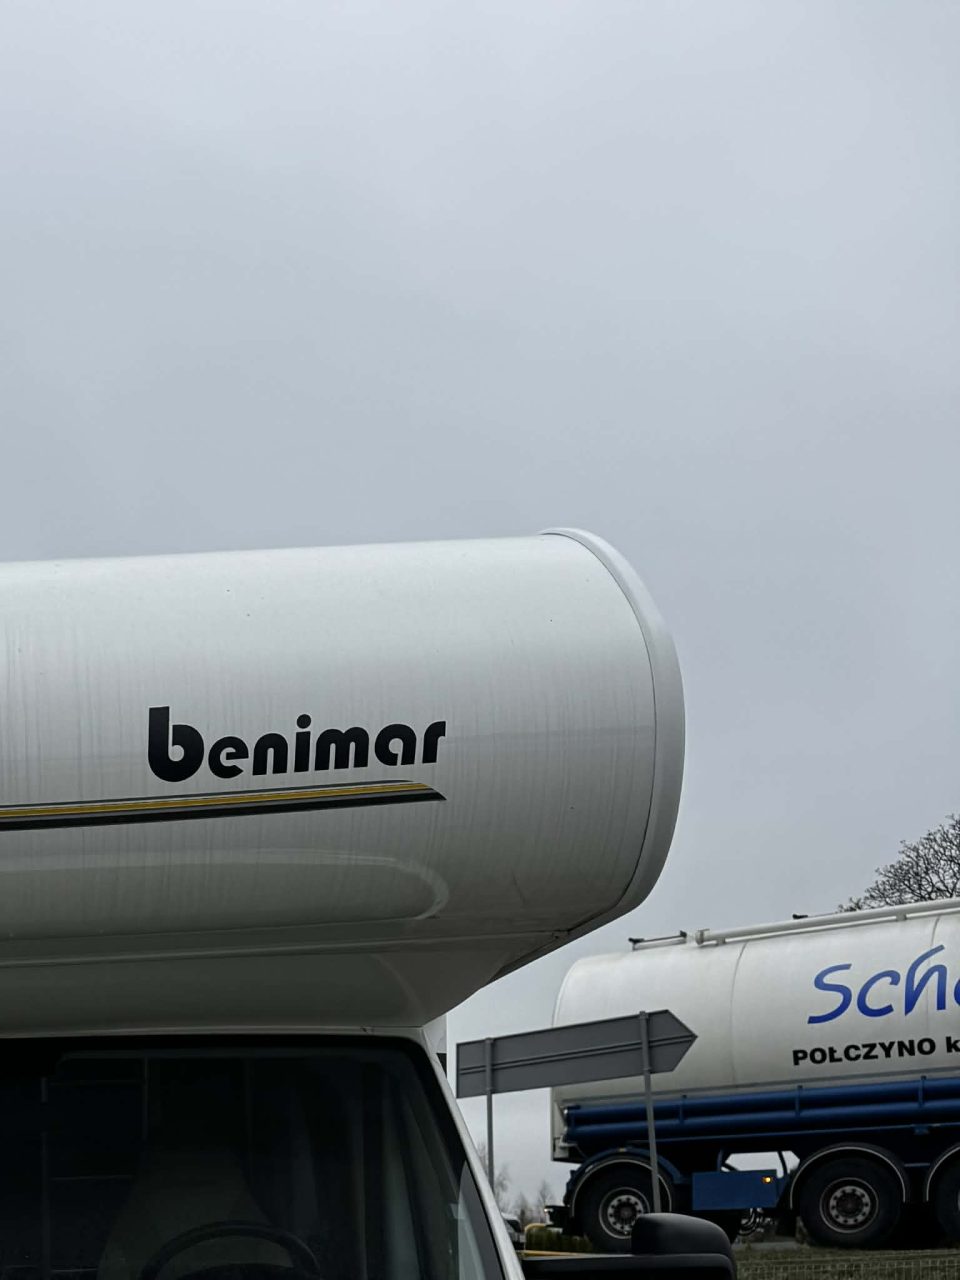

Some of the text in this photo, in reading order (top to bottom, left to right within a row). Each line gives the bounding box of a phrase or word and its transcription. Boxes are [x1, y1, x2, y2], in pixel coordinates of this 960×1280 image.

[147, 706, 446, 782] benimar
[807, 944, 960, 1024] Sch
[792, 1038, 936, 1066] POŁCZYNO
